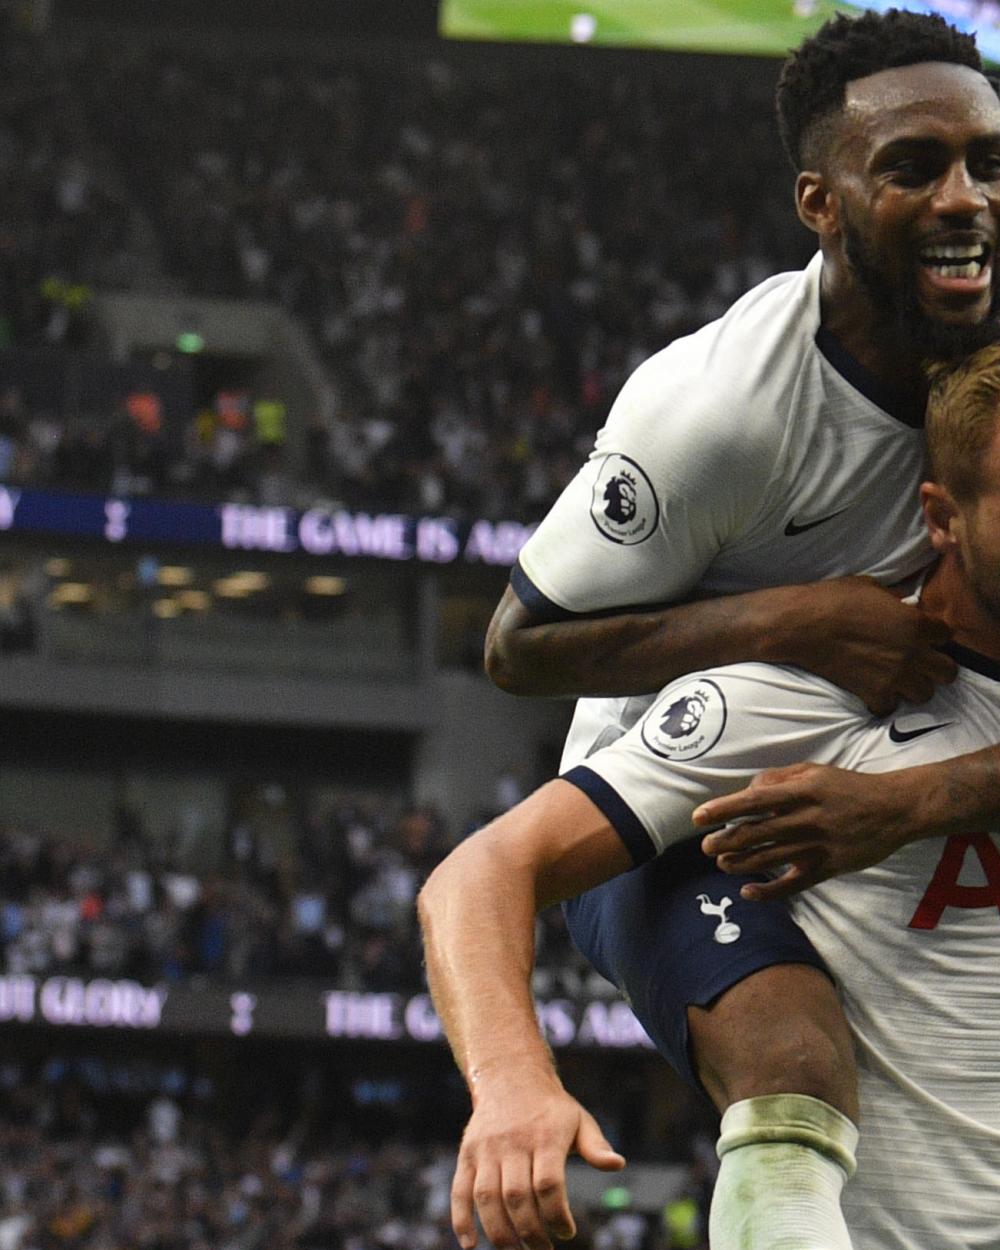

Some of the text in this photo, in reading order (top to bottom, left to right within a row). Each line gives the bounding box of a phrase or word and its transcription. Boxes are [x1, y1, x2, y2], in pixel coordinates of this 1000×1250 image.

[221, 503, 539, 566] THE GAME IS AB
[40, 975, 168, 1029] GLORY
[324, 990, 400, 1040] THE
[579, 1001, 657, 1050] AB
